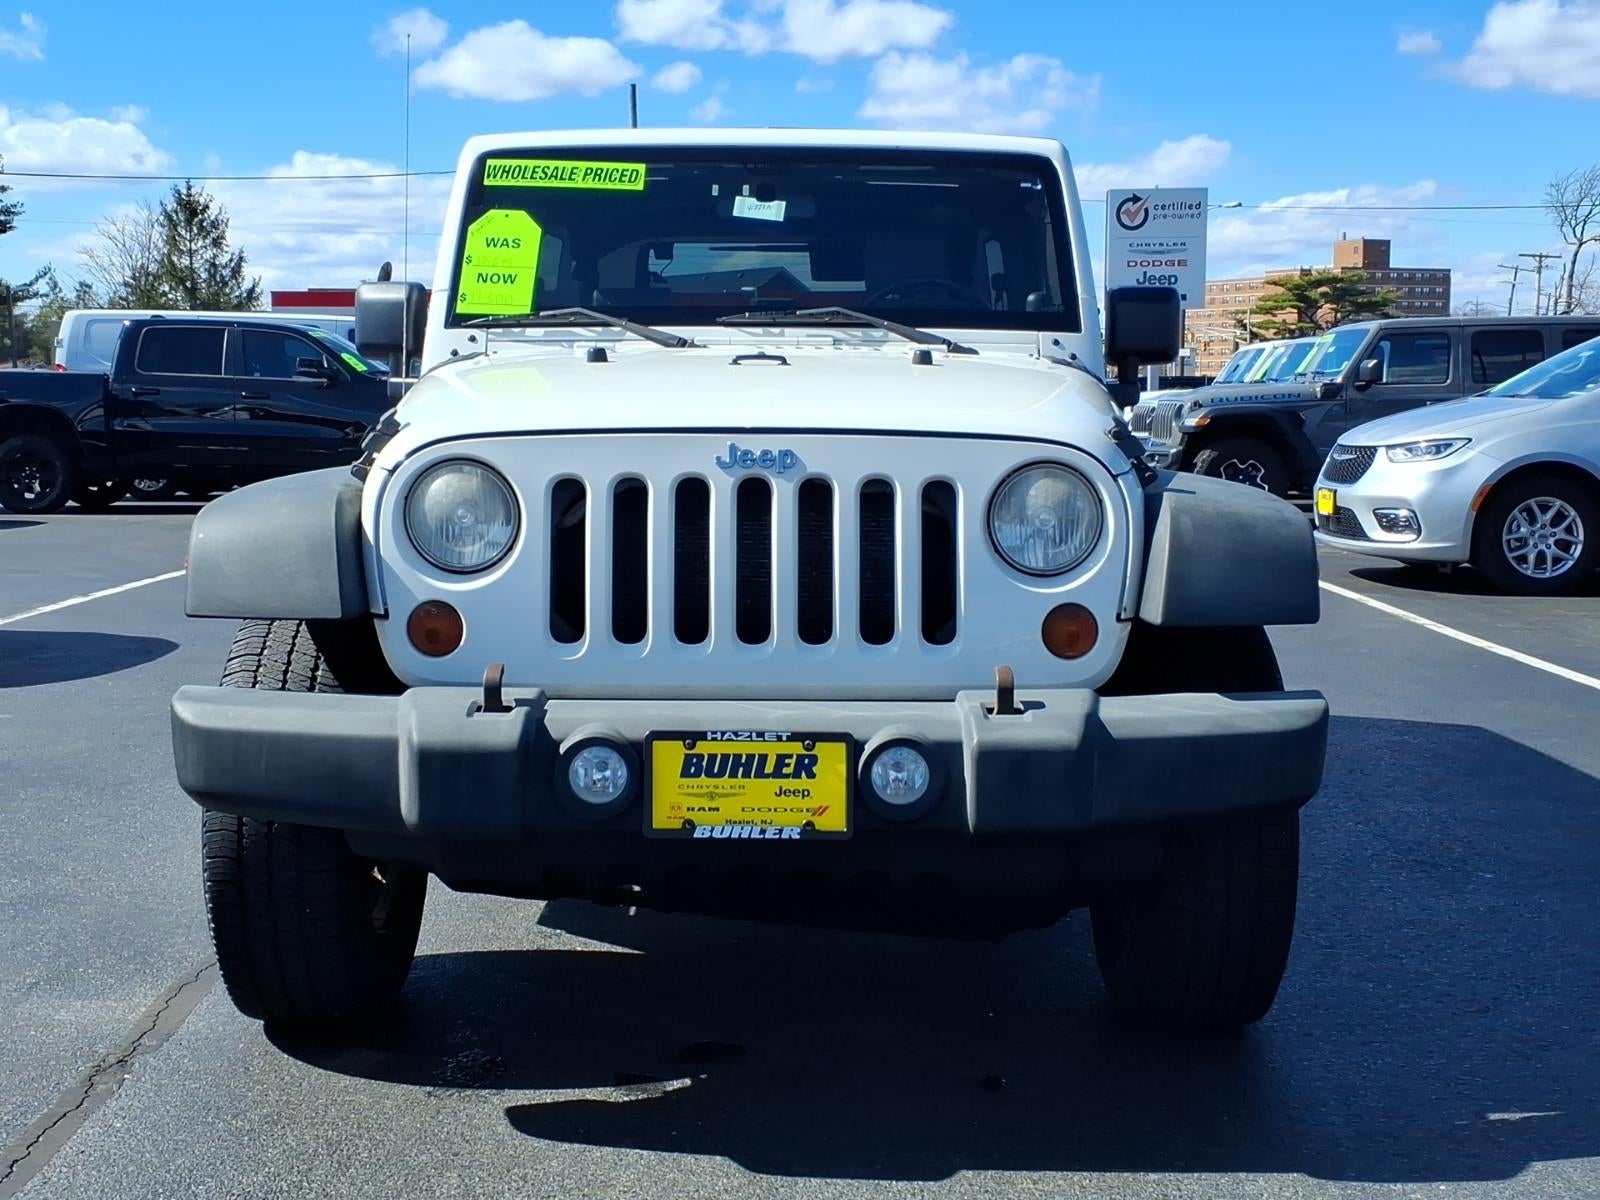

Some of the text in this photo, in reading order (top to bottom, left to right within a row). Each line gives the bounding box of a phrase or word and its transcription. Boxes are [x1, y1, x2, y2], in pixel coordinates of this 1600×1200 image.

[486, 164, 641, 184] WHOLESALE PRICED
[1153, 201, 1201, 211] certified
[1152, 211, 1201, 221] pre-owned
[485, 237, 521, 249] WAS
[1127, 259, 1188, 268] DODGE
[476, 272, 518, 285] NOW
[1136, 271, 1178, 286] Jeep
[1210, 393, 1301, 404] RUBICON
[714, 441, 797, 474] Jeep
[706, 731, 791, 741] HAZLET
[679, 753, 818, 780] BUHLER
[774, 785, 811, 799] Jeep
[725, 818, 758, 826] Hazlet,
[693, 825, 801, 839] BUHLER
